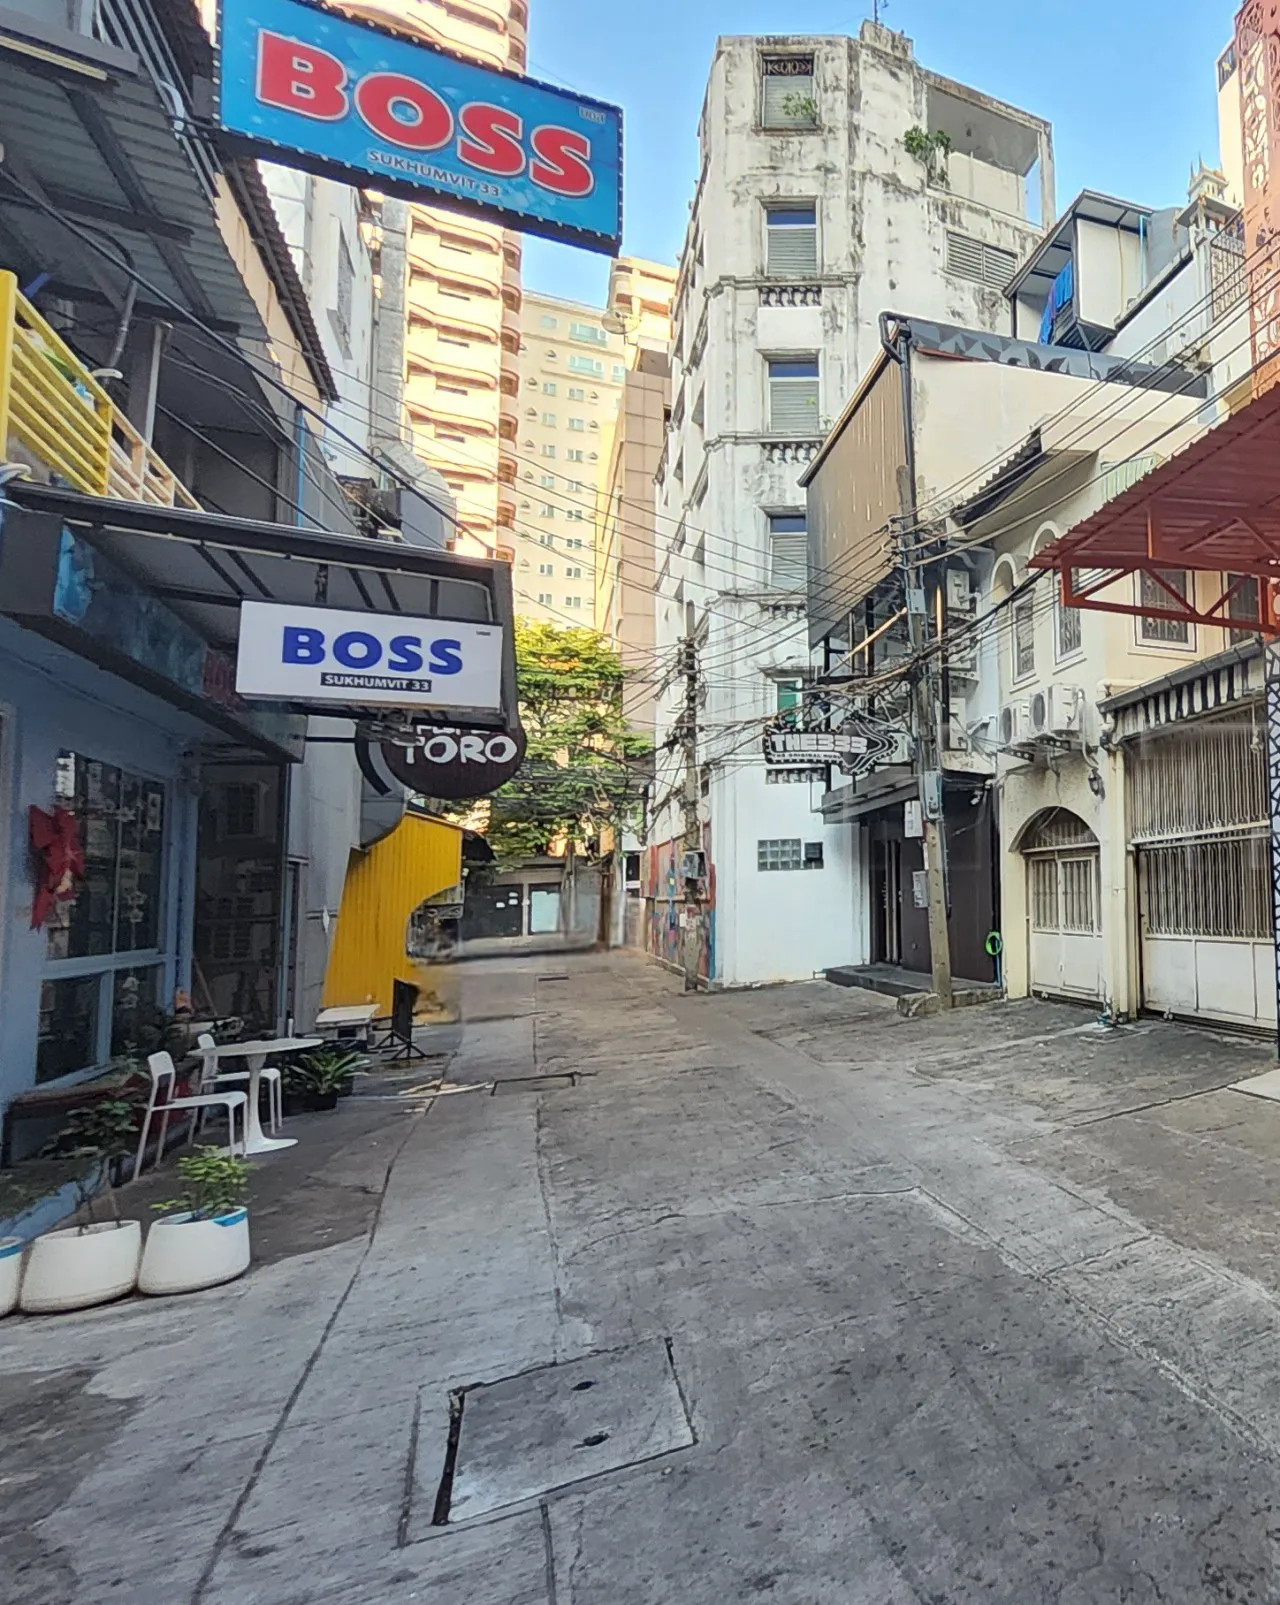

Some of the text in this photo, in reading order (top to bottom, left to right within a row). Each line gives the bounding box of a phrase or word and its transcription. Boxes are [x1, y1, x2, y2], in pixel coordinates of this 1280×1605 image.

[255, 28, 595, 197] BOSS
[369, 150, 500, 197] SUKHUMVIT 33
[281, 625, 463, 675] BOSS
[324, 674, 430, 691] SUKHUMVIT 33
[391, 735, 518, 764] TORO
